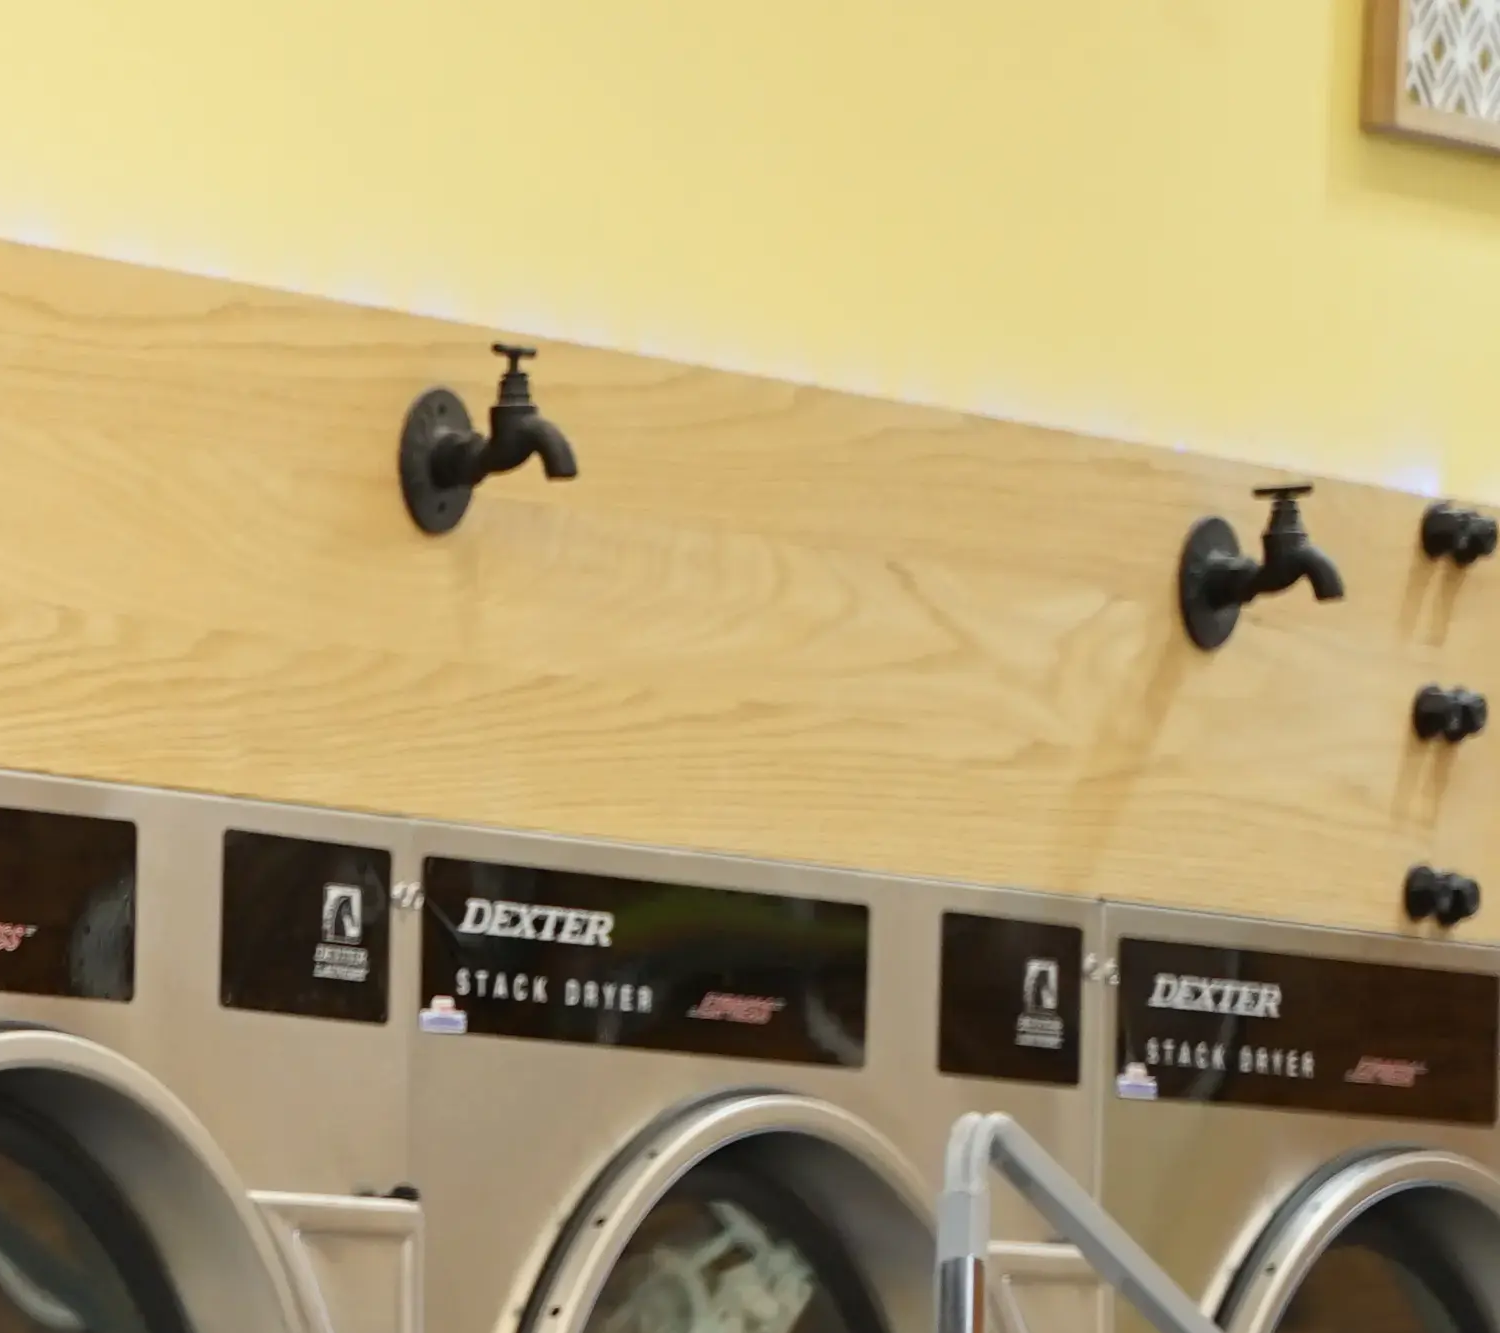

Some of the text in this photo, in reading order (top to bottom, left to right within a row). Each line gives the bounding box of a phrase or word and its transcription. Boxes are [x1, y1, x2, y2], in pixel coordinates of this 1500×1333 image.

[457, 898, 614, 947] DEXTER
[455, 967, 548, 1004] STACK
[564, 978, 653, 1013] DRYER
[1147, 972, 1282, 1018] DEXTER
[1146, 1037, 1227, 1071] STACK
